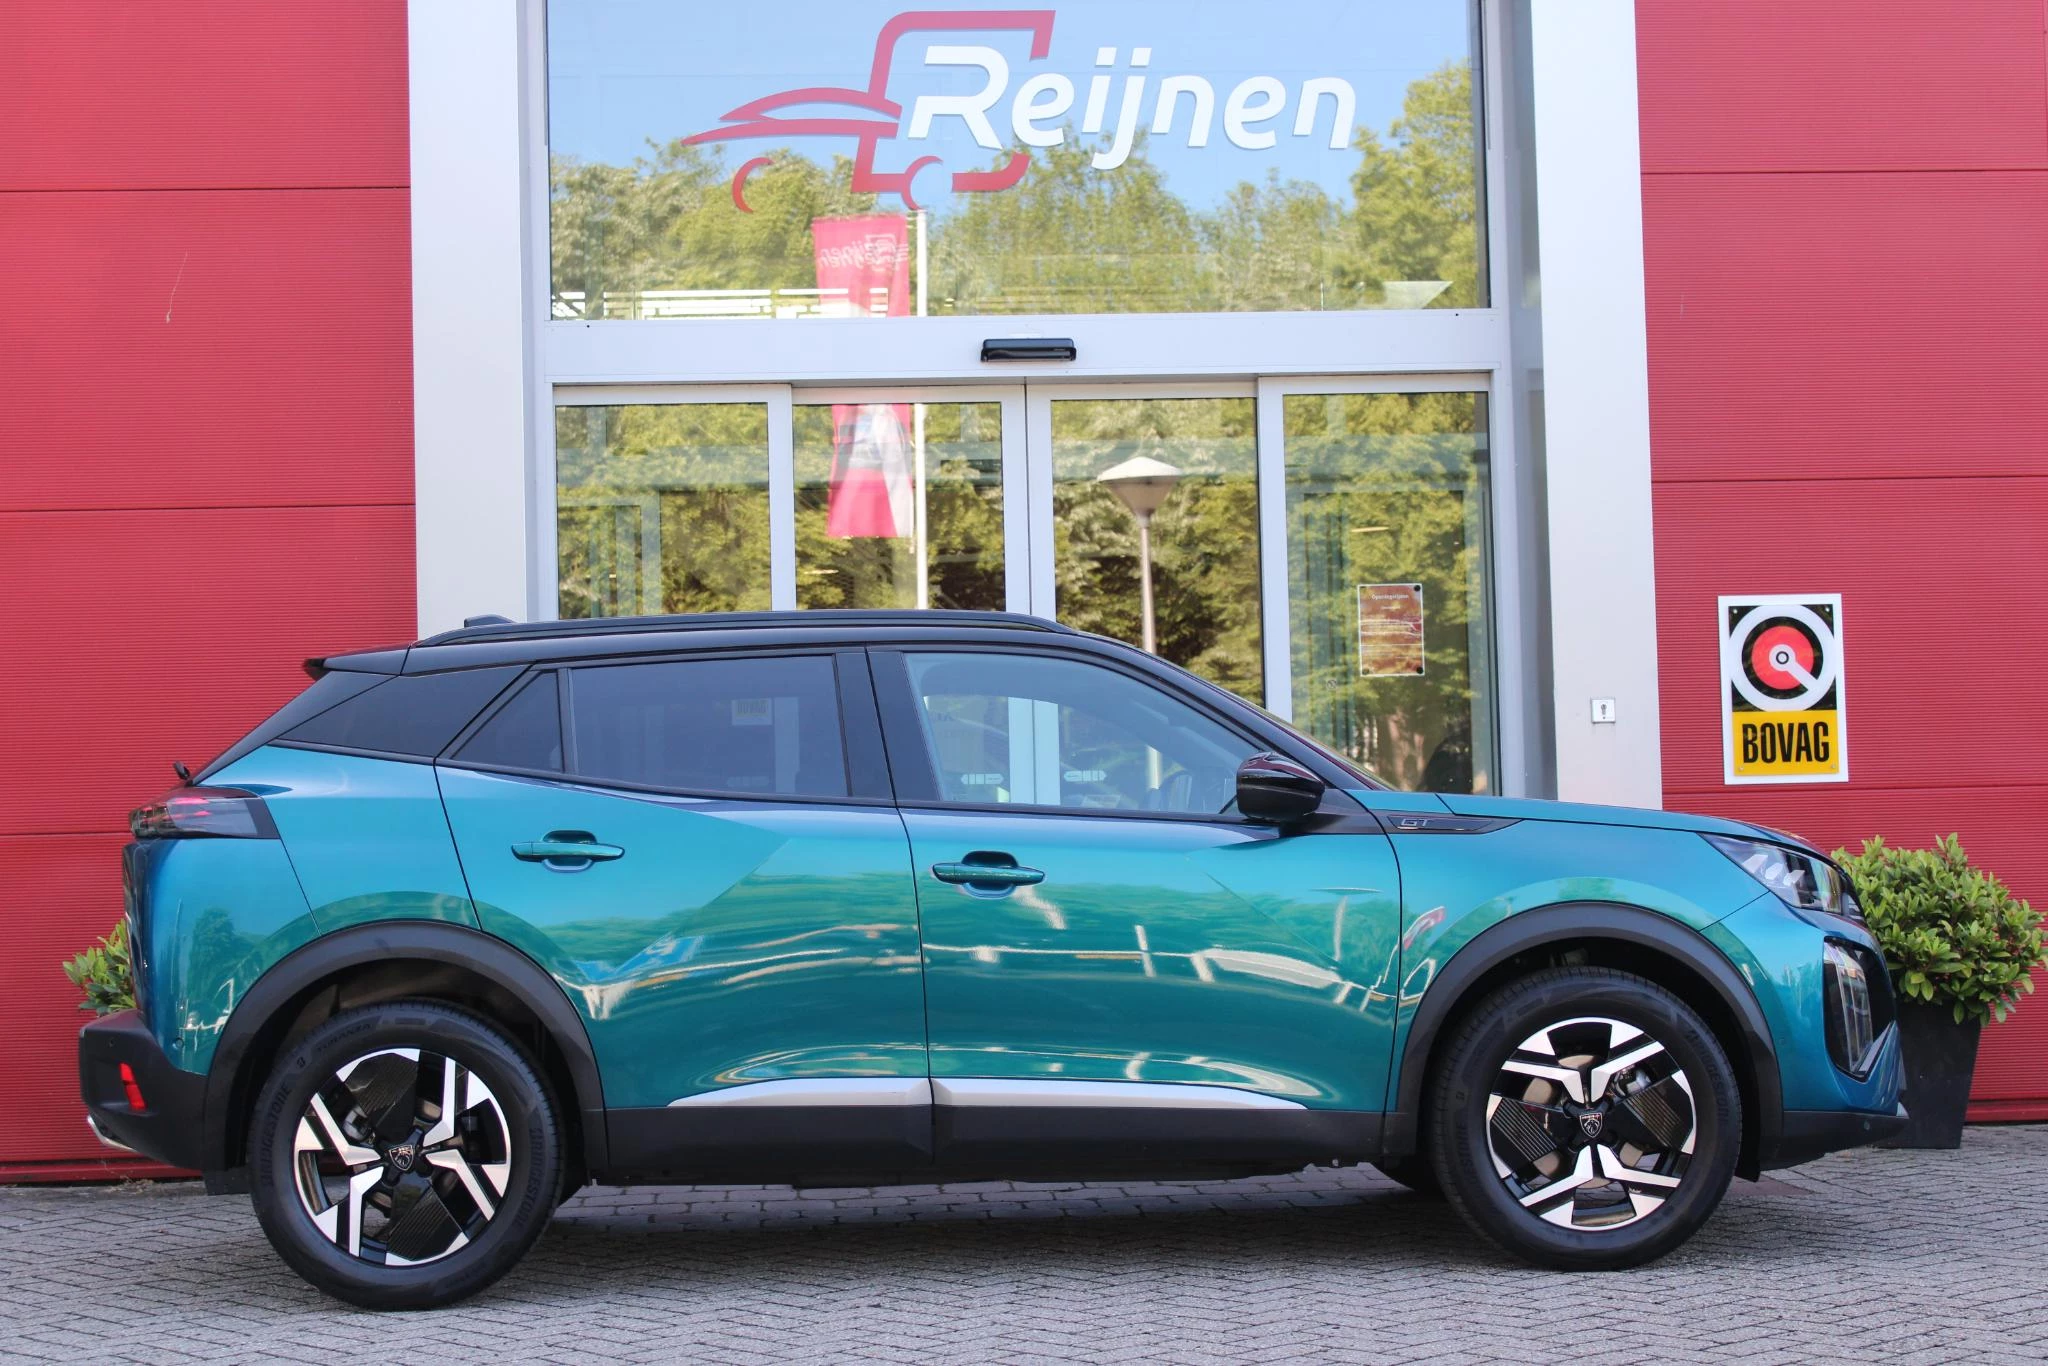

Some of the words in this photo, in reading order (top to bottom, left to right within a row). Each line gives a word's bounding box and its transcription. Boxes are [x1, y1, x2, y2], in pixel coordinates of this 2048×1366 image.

[907, 45, 1356, 170] Reijnen
[1741, 721, 1830, 764] BOVAG
[1400, 818, 1428, 827] GT
[259, 1080, 293, 1187] BRIDGESTONE
